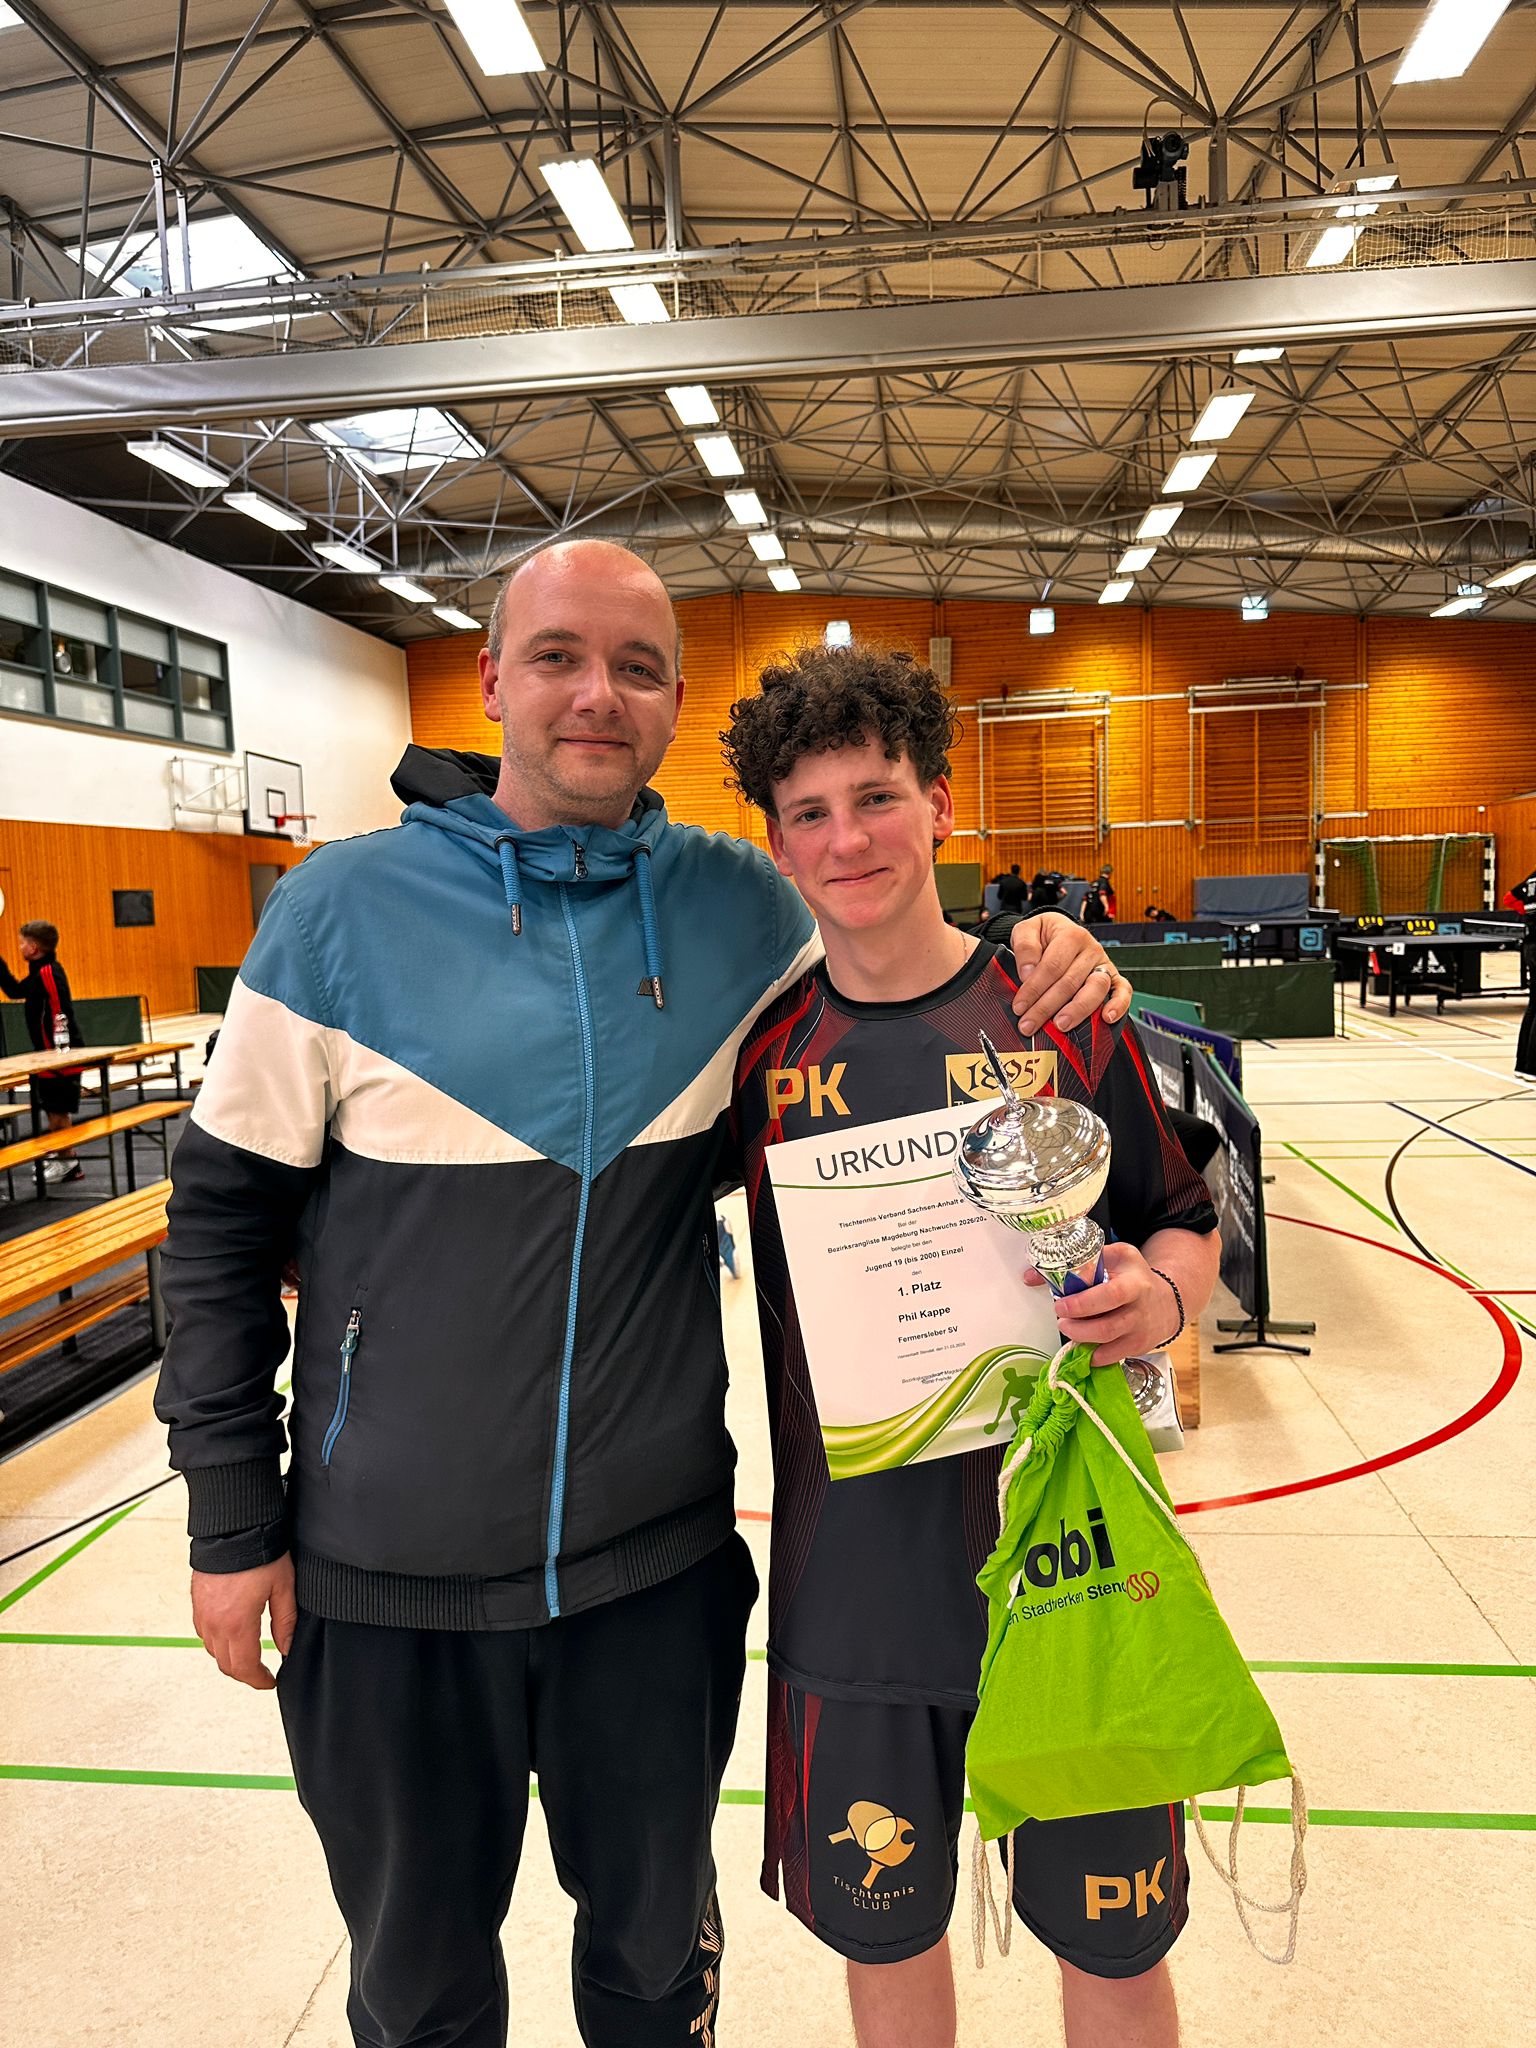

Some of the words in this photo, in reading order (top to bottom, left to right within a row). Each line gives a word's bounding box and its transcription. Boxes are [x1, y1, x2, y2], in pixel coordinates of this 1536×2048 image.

[766, 1062, 851, 1119] PK
[838, 1209, 906, 1229] Tischtennis-Verband
[907, 1199, 959, 1214] Sachsen-Anhalt
[827, 1237, 880, 1254] Bezirksrangliste
[881, 1229, 918, 1243] Magdeburg
[919, 1221, 958, 1234] Nachwuchs
[865, 1261, 892, 1273] Jugend
[894, 1258, 903, 1266] 19
[904, 1255, 918, 1265] (bis
[919, 1251, 940, 1261] 2000)
[941, 1246, 964, 1257] Einzel
[897, 1287, 909, 1297] 1.
[911, 1281, 942, 1294] Platz
[898, 1312, 917, 1323] Phil
[919, 1306, 951, 1318] Kappe
[898, 1329, 946, 1343] Fermersleber
[948, 1325, 958, 1334] SV
[1016, 1505, 1116, 1597] obi
[833, 1875, 915, 1899] Tischtennis
[1085, 1856, 1167, 1920] PK
[853, 1896, 890, 1911] CLUB
